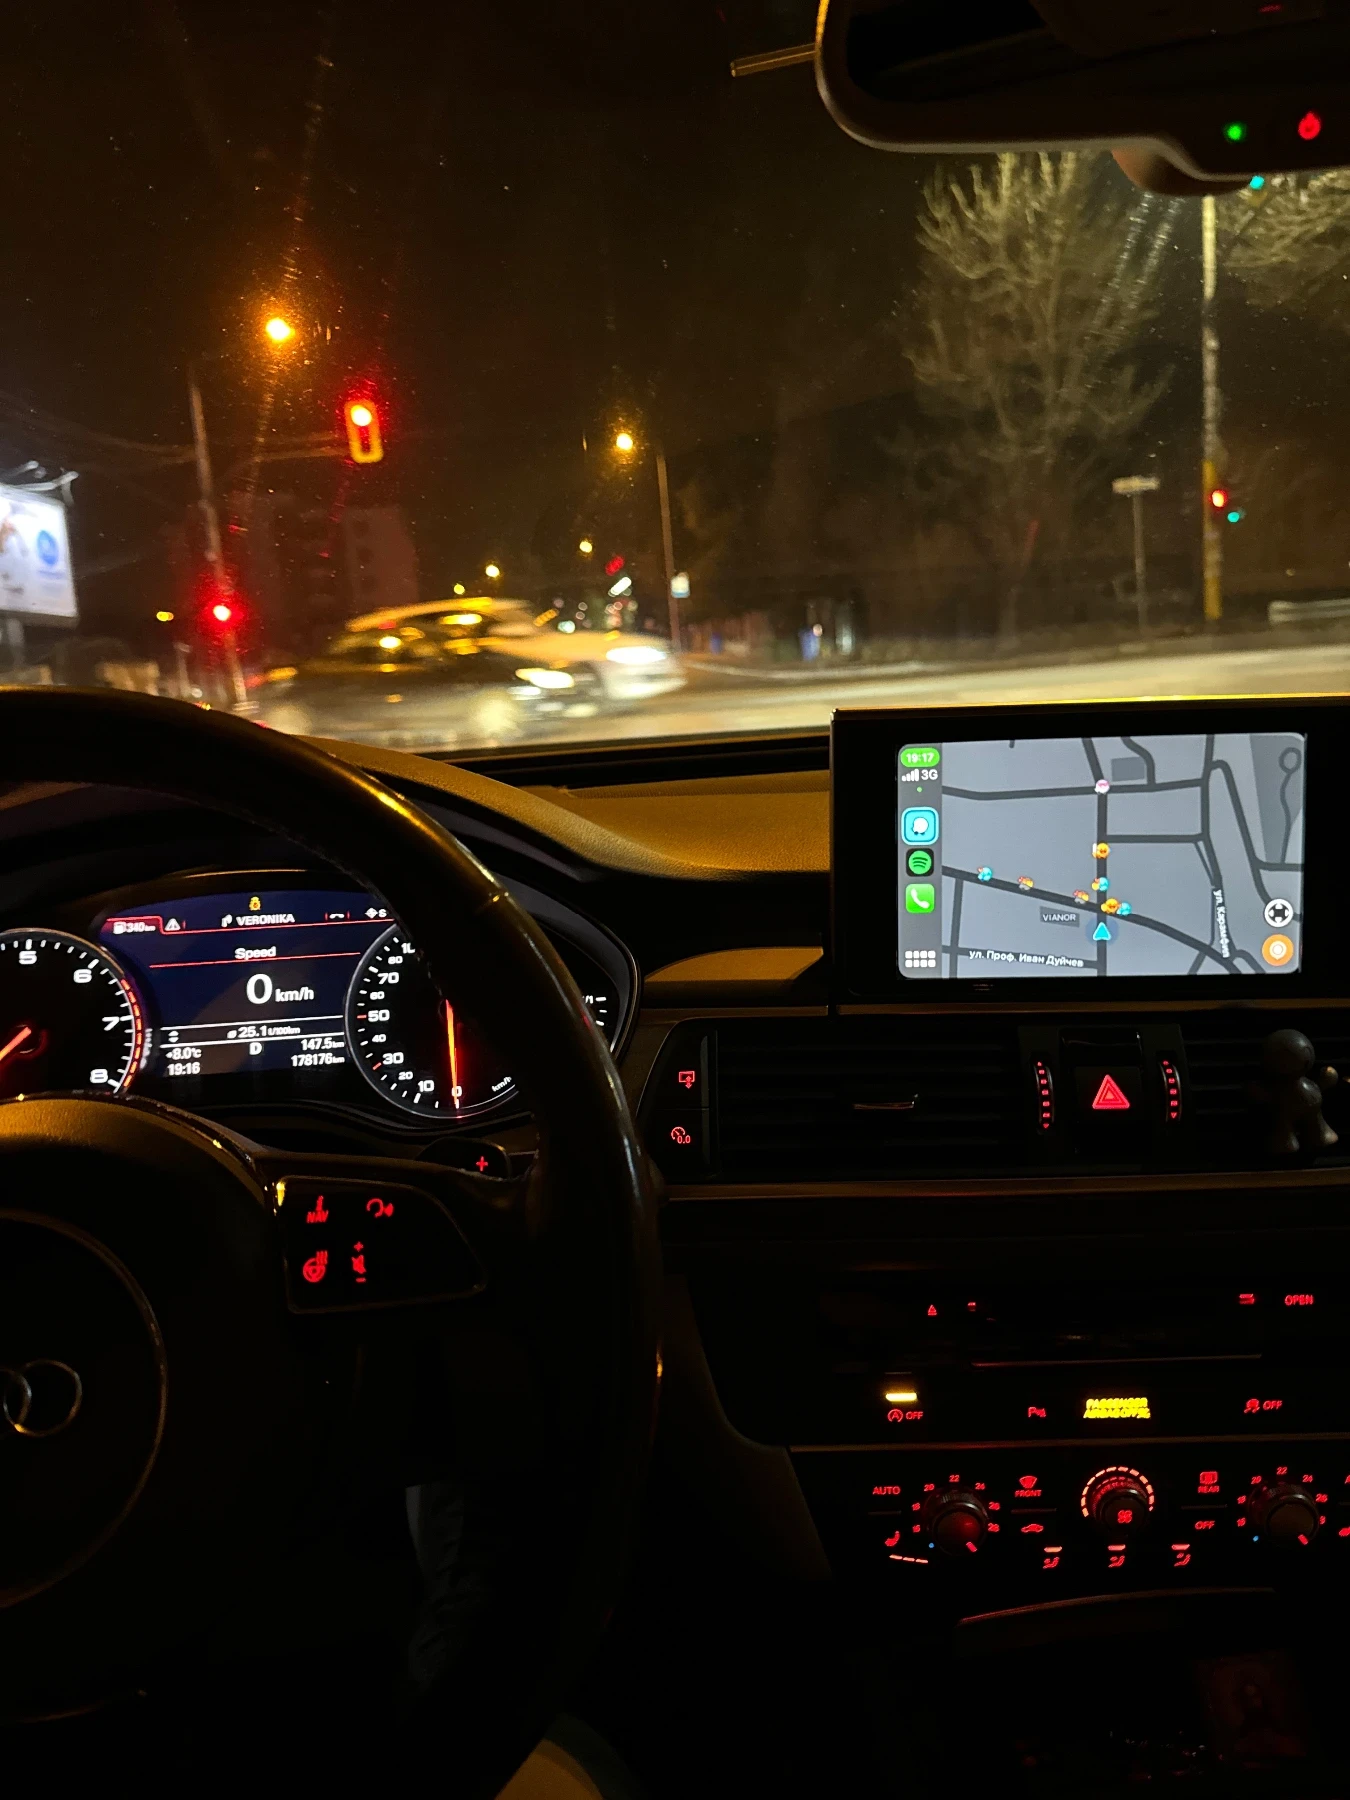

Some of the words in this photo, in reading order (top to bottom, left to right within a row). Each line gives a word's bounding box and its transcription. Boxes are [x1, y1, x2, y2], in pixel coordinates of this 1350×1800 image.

[906, 752, 935, 764] 19:17
[921, 769, 938, 780] 3G
[236, 914, 295, 926] VERONIKA
[19, 951, 37, 965] 5
[235, 946, 276, 960] Speed
[969, 950, 984, 959] ул.
[987, 950, 1017, 962] Проф.
[1019, 953, 1044, 964] Иван
[1046, 955, 1084, 967] Дуйчев
[73, 969, 92, 983] 6
[378, 972, 399, 983] 70
[246, 974, 272, 1004] 0
[275, 987, 314, 1002] km/h
[370, 991, 385, 1000] 60
[368, 1010, 390, 1021] 50
[102, 1017, 120, 1031] 7
[372, 1034, 386, 1043] 40
[249, 1042, 262, 1055] D
[382, 1052, 404, 1064] 30
[167, 1062, 200, 1076] 19:16
[90, 1069, 108, 1083] 8
[399, 1071, 413, 1080] 20
[418, 1081, 434, 1091] 10
[452, 1086, 462, 1096] 0
[677, 1135, 691, 1144] 0.0
[306, 1210, 329, 1223] NAV
[1285, 1294, 1314, 1306] OPEN
[1263, 1400, 1283, 1410] OFF
[906, 1411, 923, 1420] OFF
[1276, 1466, 1287, 1475] 22
[1251, 1475, 1262, 1484] 20
[1302, 1474, 1313, 1483] 24
[873, 1486, 900, 1495] AUTO
[924, 1483, 935, 1492] 20
[1197, 1485, 1220, 1493] REAR
[1014, 1489, 1042, 1498] FRONT
[1194, 1520, 1215, 1530] OFF
